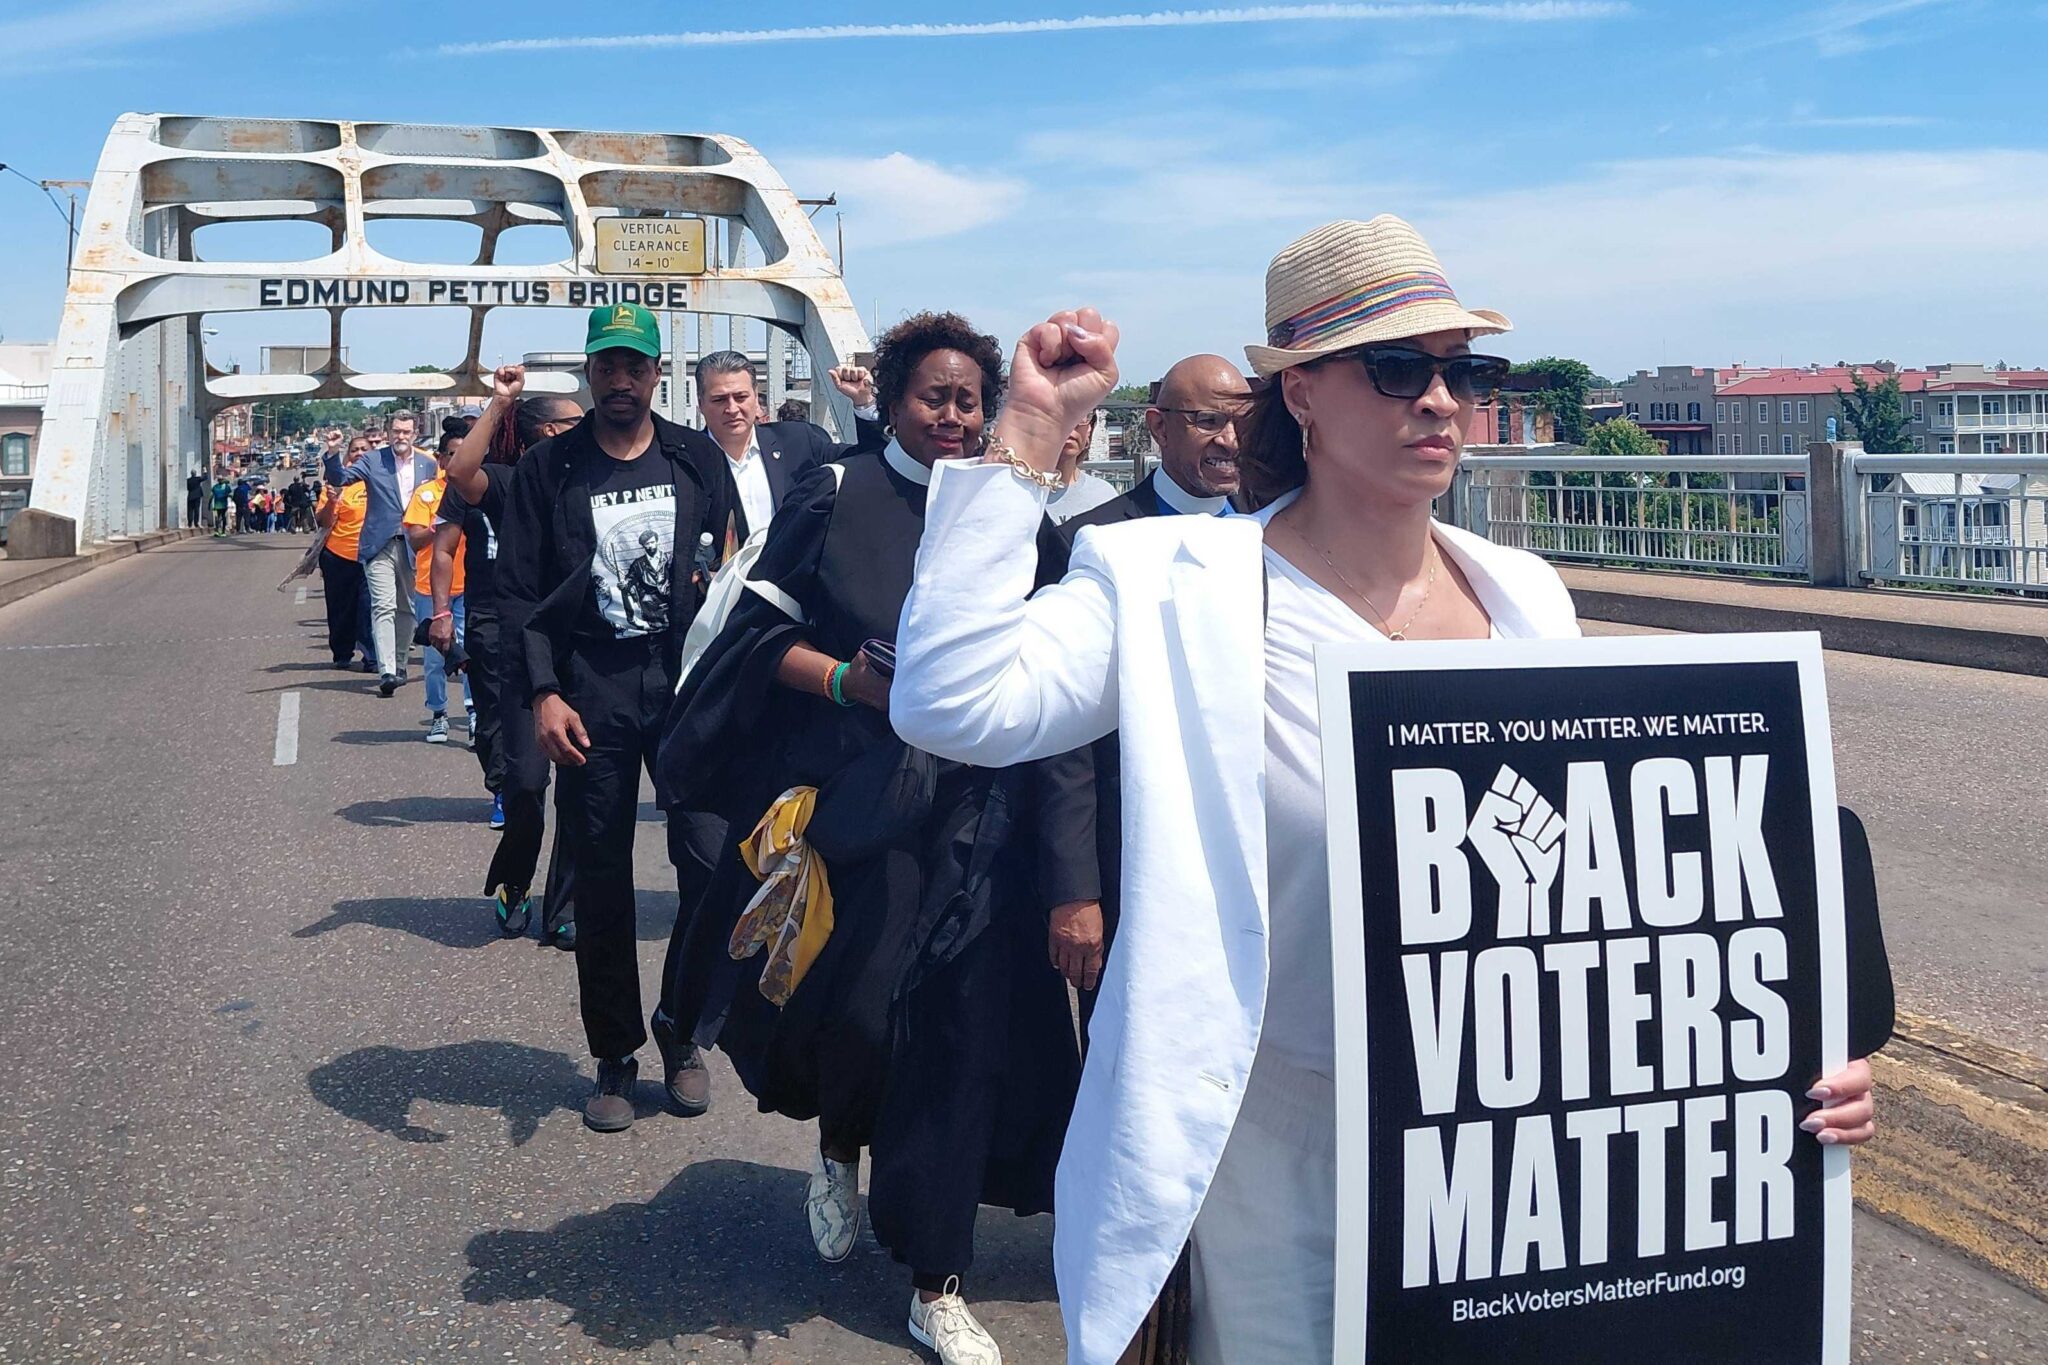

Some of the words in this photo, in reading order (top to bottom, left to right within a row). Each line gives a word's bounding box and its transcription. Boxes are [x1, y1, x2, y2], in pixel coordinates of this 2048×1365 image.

[620, 223, 681, 235] VERTICAL
[613, 240, 690, 252] CLEARANCE
[259, 278, 411, 306] EDMUND
[428, 279, 551, 306] PETTUS
[568, 280, 688, 308] BRIDGE
[590, 491, 619, 509] UEY
[623, 489, 633, 503] P
[635, 484, 677, 503] NEWT
[1388, 724, 1395, 746] I
[1401, 722, 1495, 746] MATTER.
[1498, 719, 1547, 743] YOU
[1551, 716, 1641, 741] MATTER.
[1642, 714, 1679, 737] WE
[1683, 712, 1770, 736] MATTER.
[1401, 926, 1790, 1116] VOTERS
[1402, 1089, 1795, 1289] MATTER
[1452, 1265, 1746, 1322] BlackVotersMatterFund.org
